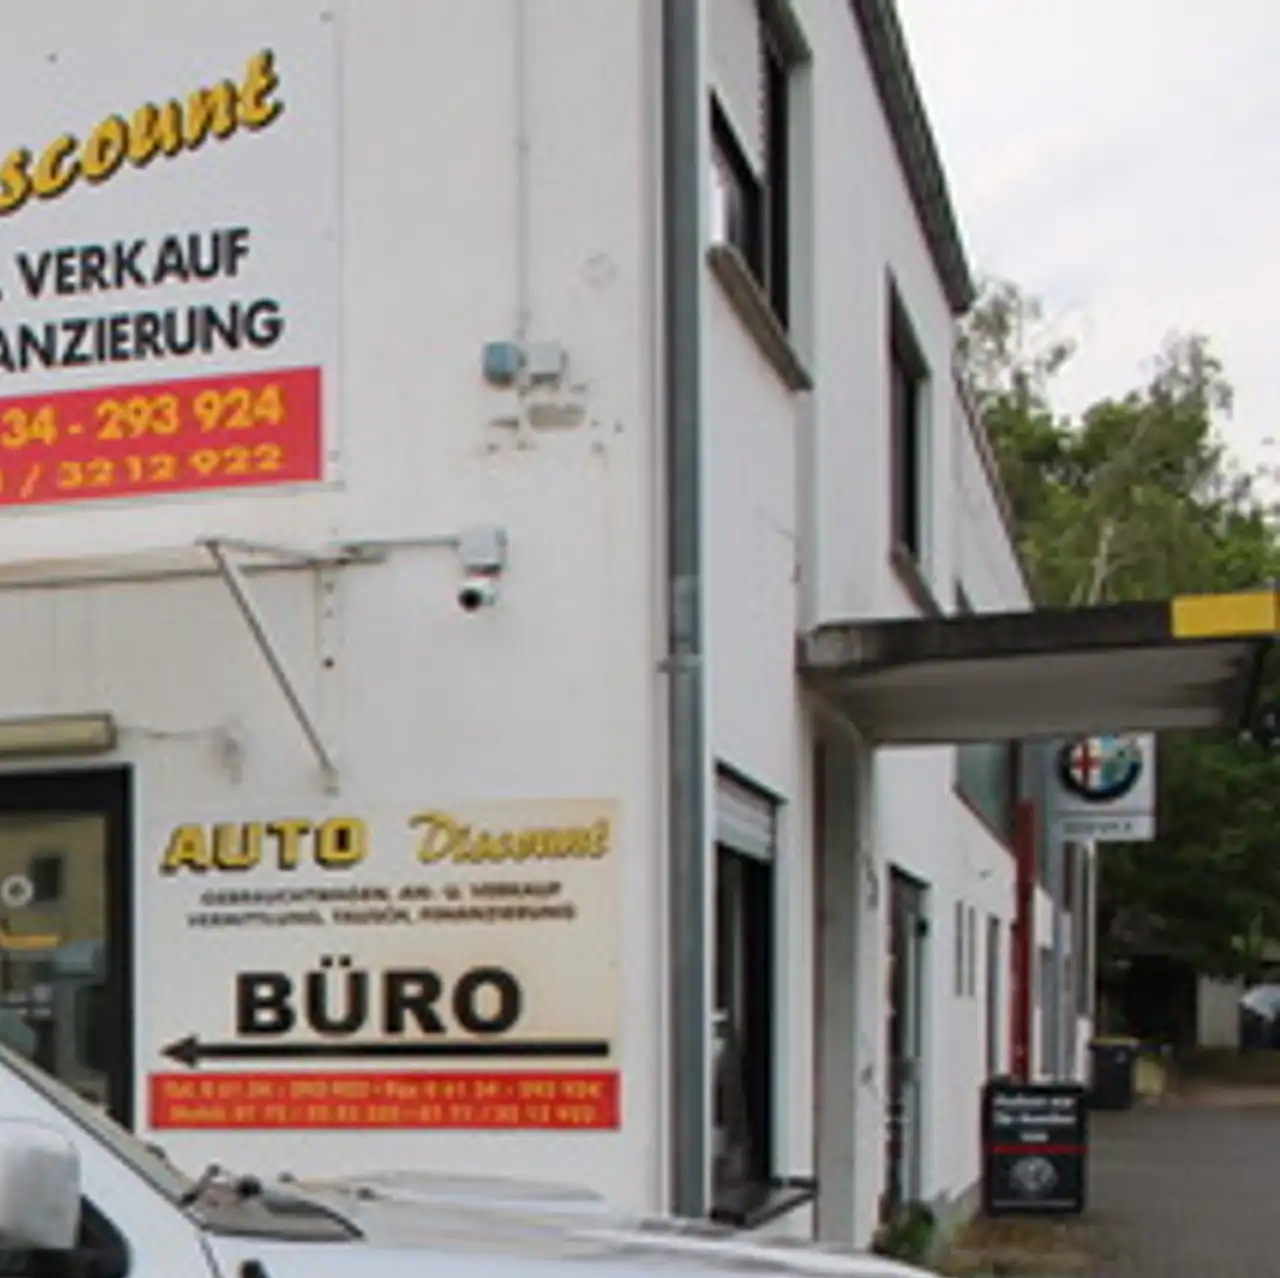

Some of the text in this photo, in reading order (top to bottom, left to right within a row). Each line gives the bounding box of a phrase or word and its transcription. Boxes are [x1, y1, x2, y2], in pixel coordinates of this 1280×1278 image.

[15, 228, 251, 299] VERKAUF
[0, 405, 57, 450] 34
[96, 395, 179, 440] 293
[193, 384, 285, 433] 924
[159, 816, 369, 876] AUTO
[235, 954, 523, 1037] BÜRO
